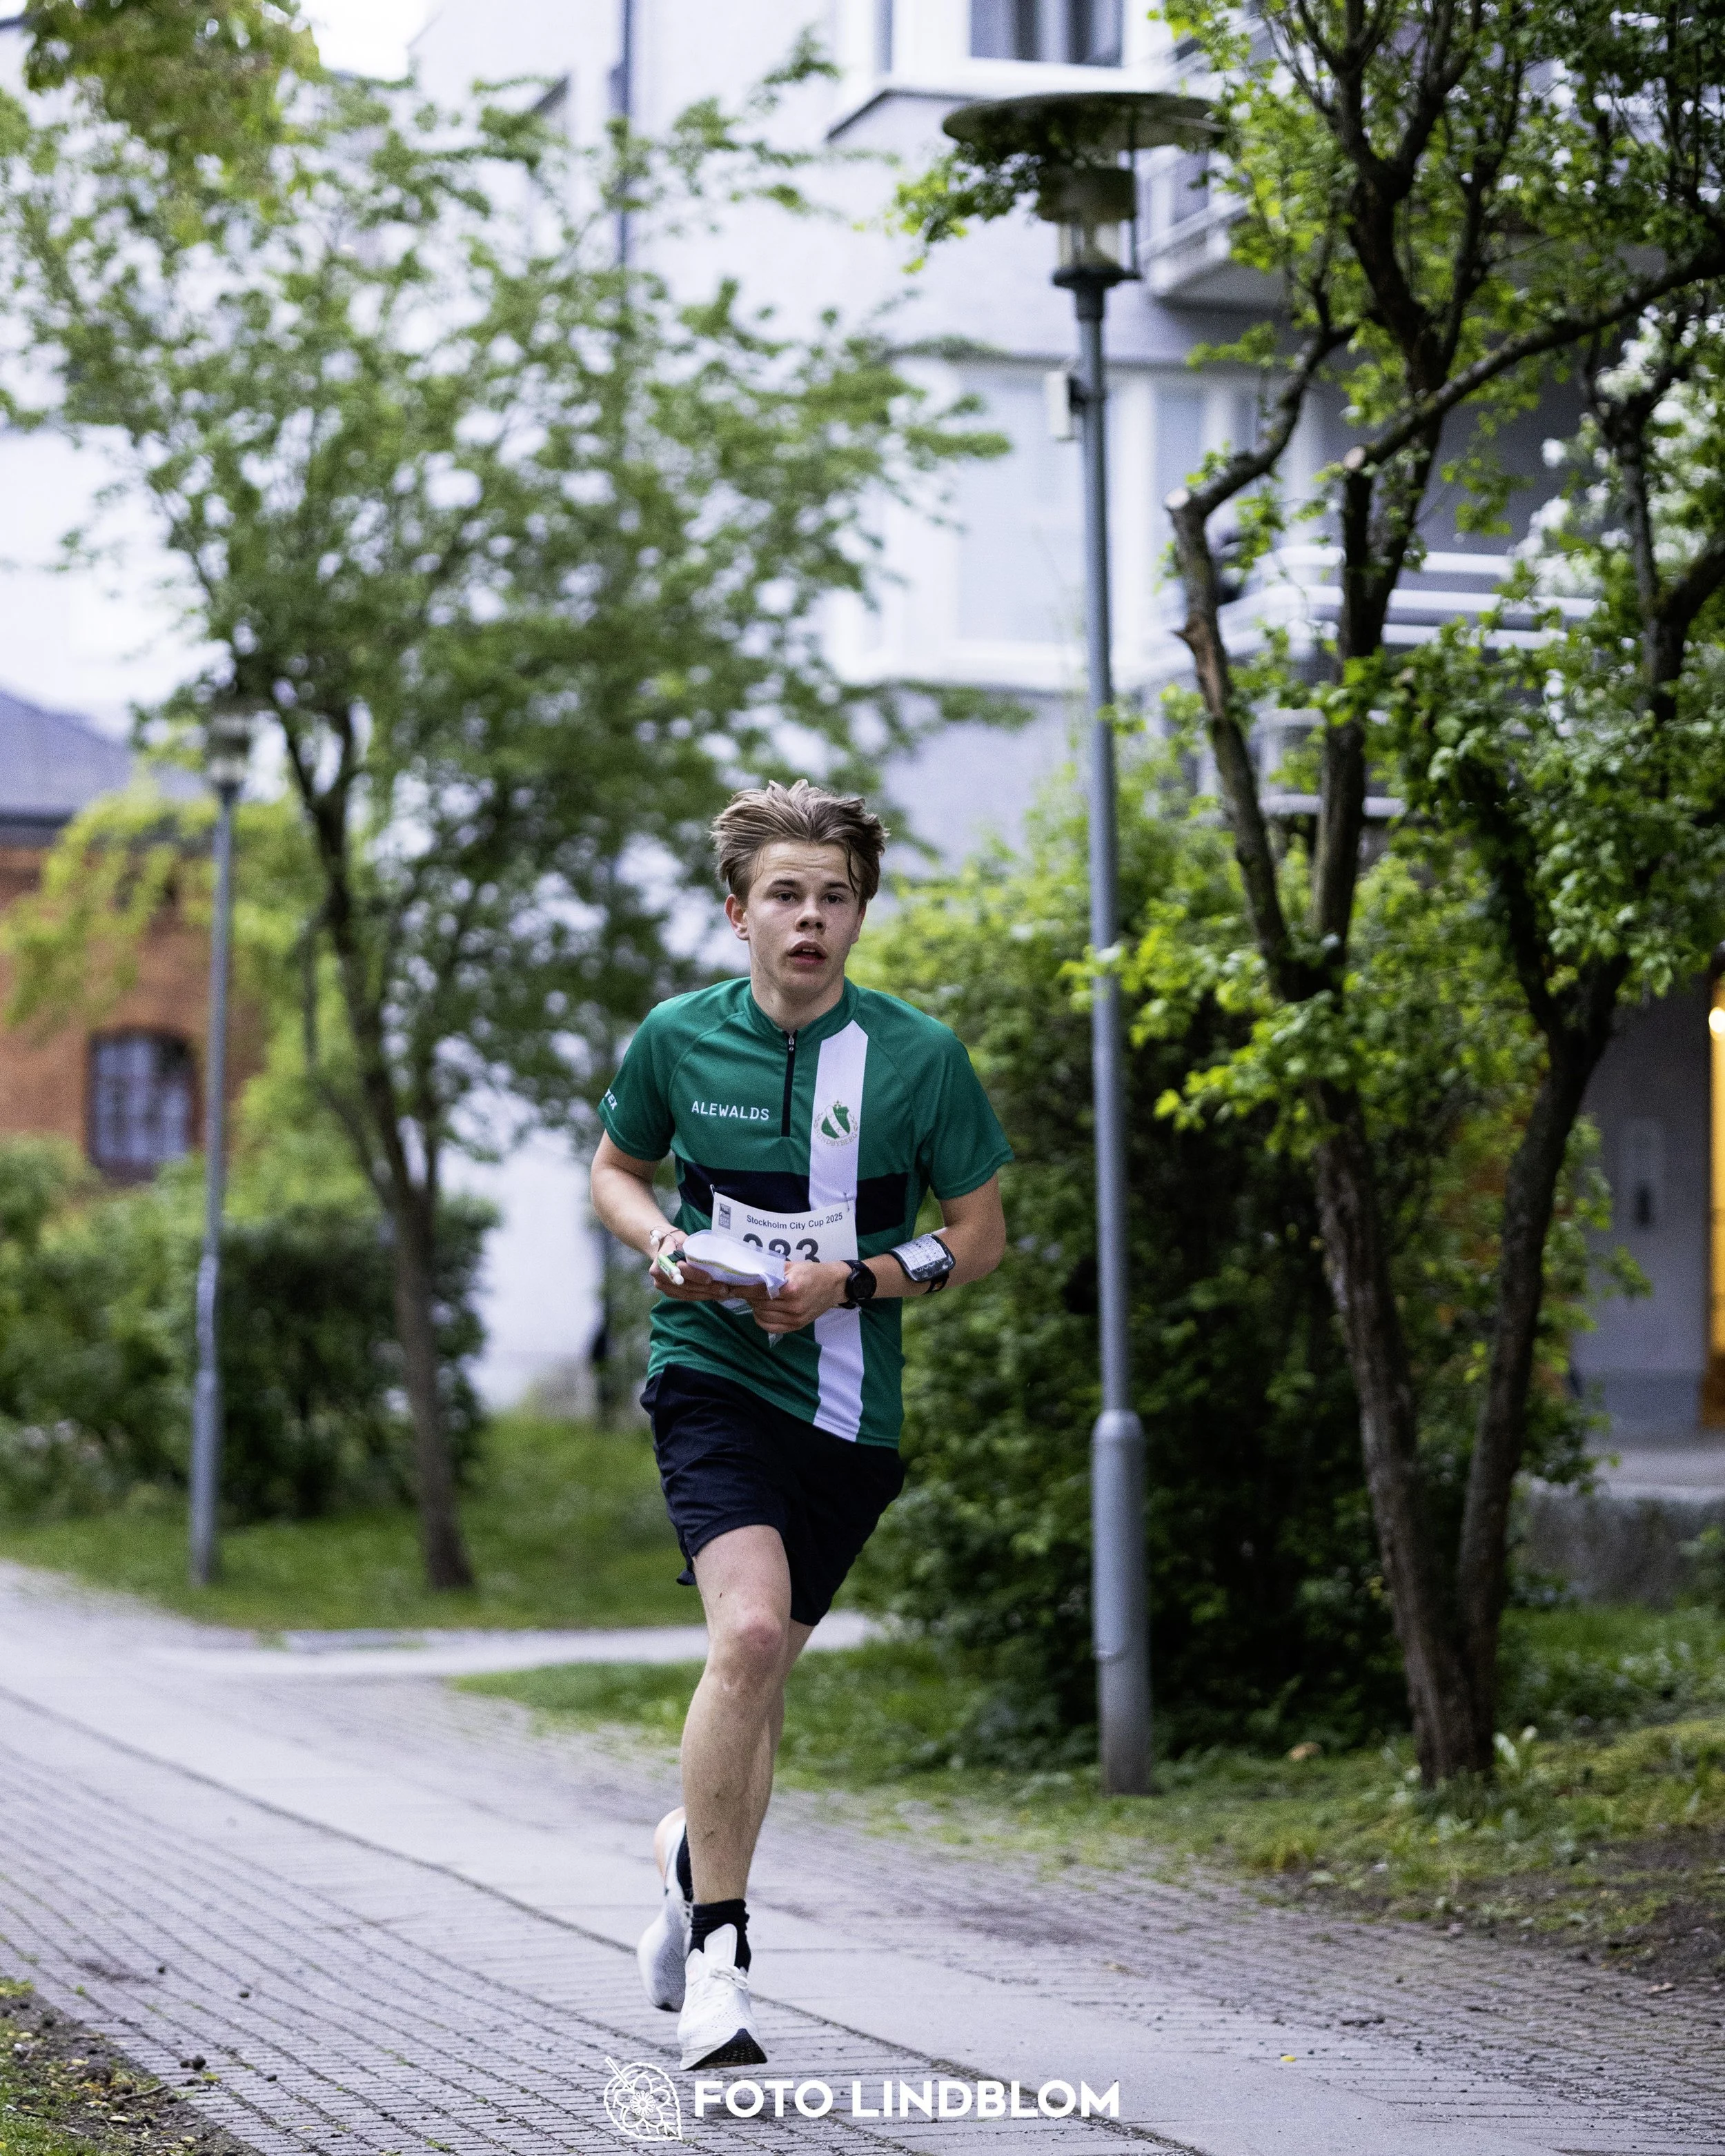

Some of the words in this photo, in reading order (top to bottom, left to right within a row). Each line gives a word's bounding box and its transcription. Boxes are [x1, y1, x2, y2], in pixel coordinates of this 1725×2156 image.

[691, 1100, 769, 1120] ALEWALDS
[747, 1214, 787, 1229] Stockholm
[789, 1222, 806, 1230] City
[808, 1219, 824, 1228] Cup
[826, 1212, 843, 1225] 2025
